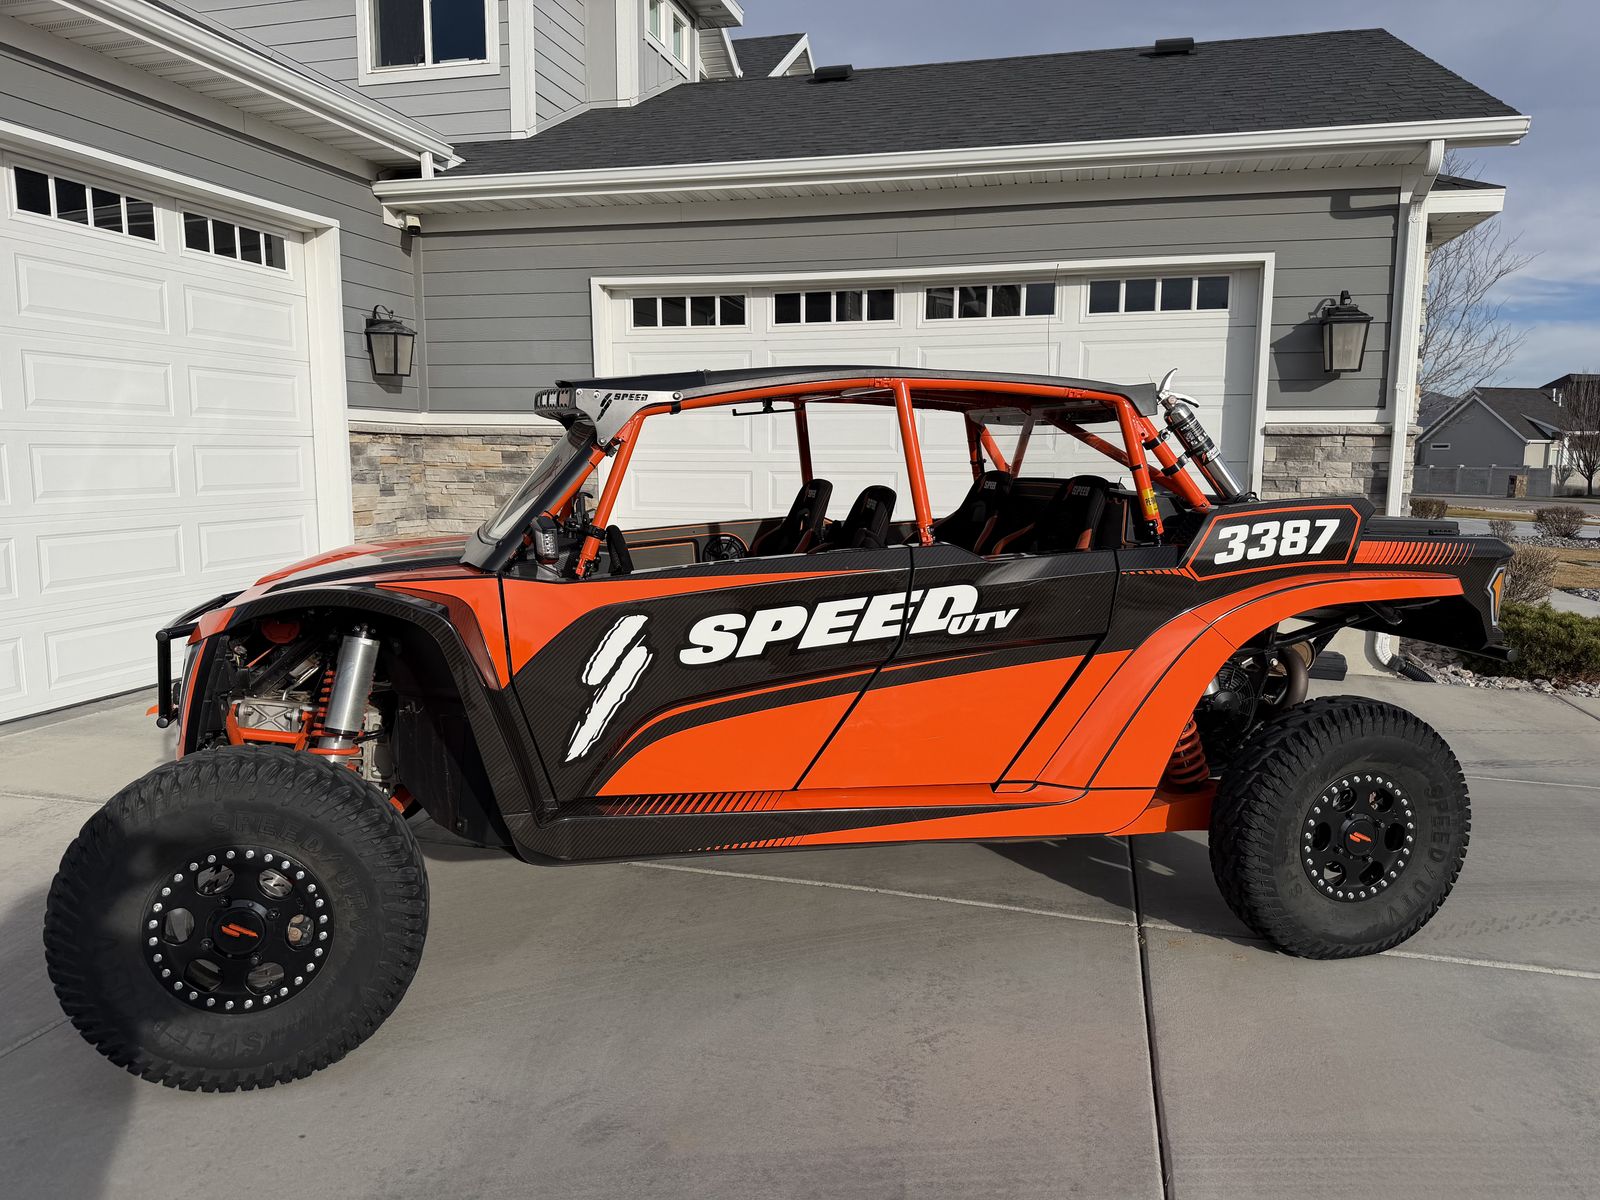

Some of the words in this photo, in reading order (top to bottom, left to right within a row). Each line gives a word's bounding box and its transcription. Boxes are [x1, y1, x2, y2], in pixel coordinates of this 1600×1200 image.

[613, 393, 649, 402] SPEED
[1214, 518, 1341, 565] 3387
[678, 583, 979, 665] SPEED
[947, 608, 1019, 635] UTV
[208, 810, 325, 854] SPEED
[1423, 783, 1451, 863] SPEED
